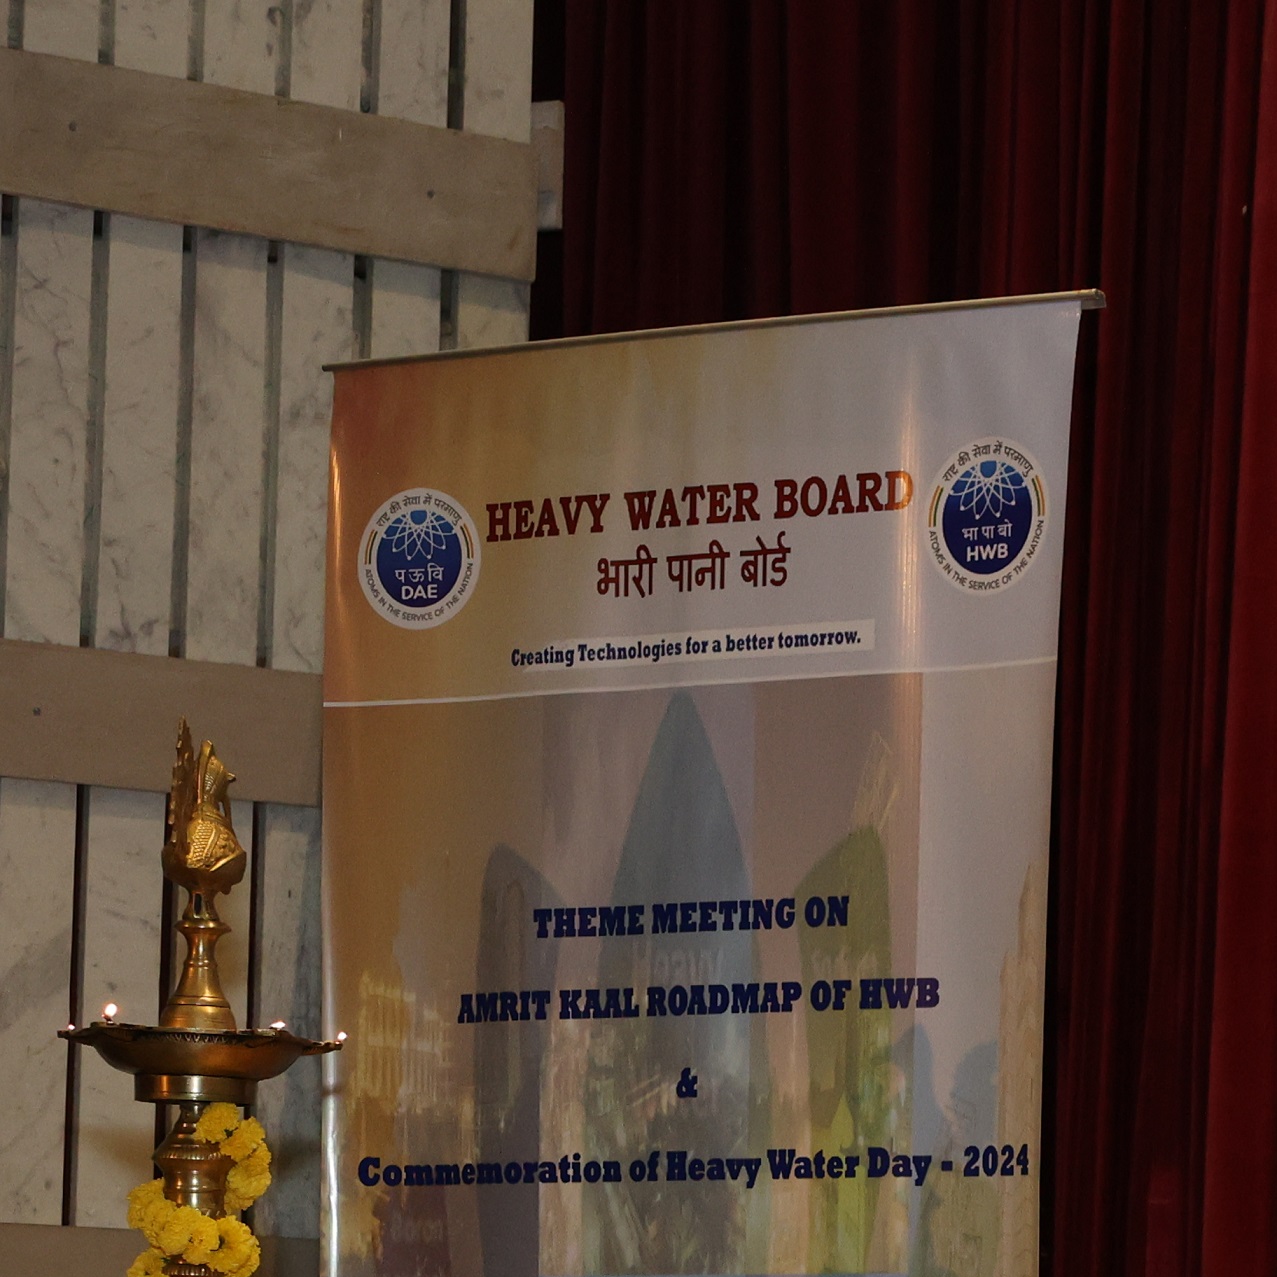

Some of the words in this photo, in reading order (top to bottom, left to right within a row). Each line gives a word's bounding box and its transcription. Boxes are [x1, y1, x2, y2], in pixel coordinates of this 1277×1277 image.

[486, 494, 610, 542] HEAVY
[624, 483, 760, 530] WATER
[774, 470, 915, 521] BOARD
[597, 545, 657, 598] भारी
[666, 540, 730, 592] पानी
[740, 531, 791, 587] बोर्ड
[929, 530, 946, 565] ATOMS
[942, 562, 953, 575] IN
[951, 572, 967, 587] THE
[968, 579, 1000, 590] SERVICE
[1002, 573, 1013, 584] OF
[1014, 559, 1028, 575] THE
[1026, 520, 1044, 560] NATION
[966, 544, 1008, 562] HWB
[365, 568, 380, 598] ATOMS
[378, 597, 386, 607] IN
[387, 604, 400, 617] THE
[402, 611, 433, 621] SERVICE
[435, 607, 445, 617] OF
[446, 594, 461, 609] THE
[457, 563, 473, 595] NATION
[402, 585, 437, 599] DAE
[511, 648, 574, 667] Creating
[578, 641, 681, 662] Technologies
[686, 637, 708, 654] for
[712, 640, 721, 652] a
[726, 634, 774, 651] better
[778, 631, 860, 648] tomorrow.
[533, 905, 644, 938] THEME
[652, 898, 795, 934] MEETING
[805, 896, 849, 927] ON
[458, 990, 550, 1023] AMRIT
[560, 988, 639, 1019] KAAL
[647, 982, 802, 1016] ROADMAP
[811, 980, 851, 1011] OF
[859, 978, 939, 1009] HWB
[676, 1067, 697, 1098] &
[358, 1153, 622, 1187] Commemoration
[629, 1151, 660, 1182] of
[666, 1151, 761, 1188] Heavy
[767, 1149, 859, 1179] Water
[868, 1147, 932, 1186] Day
[964, 1144, 1028, 1177] 2024
